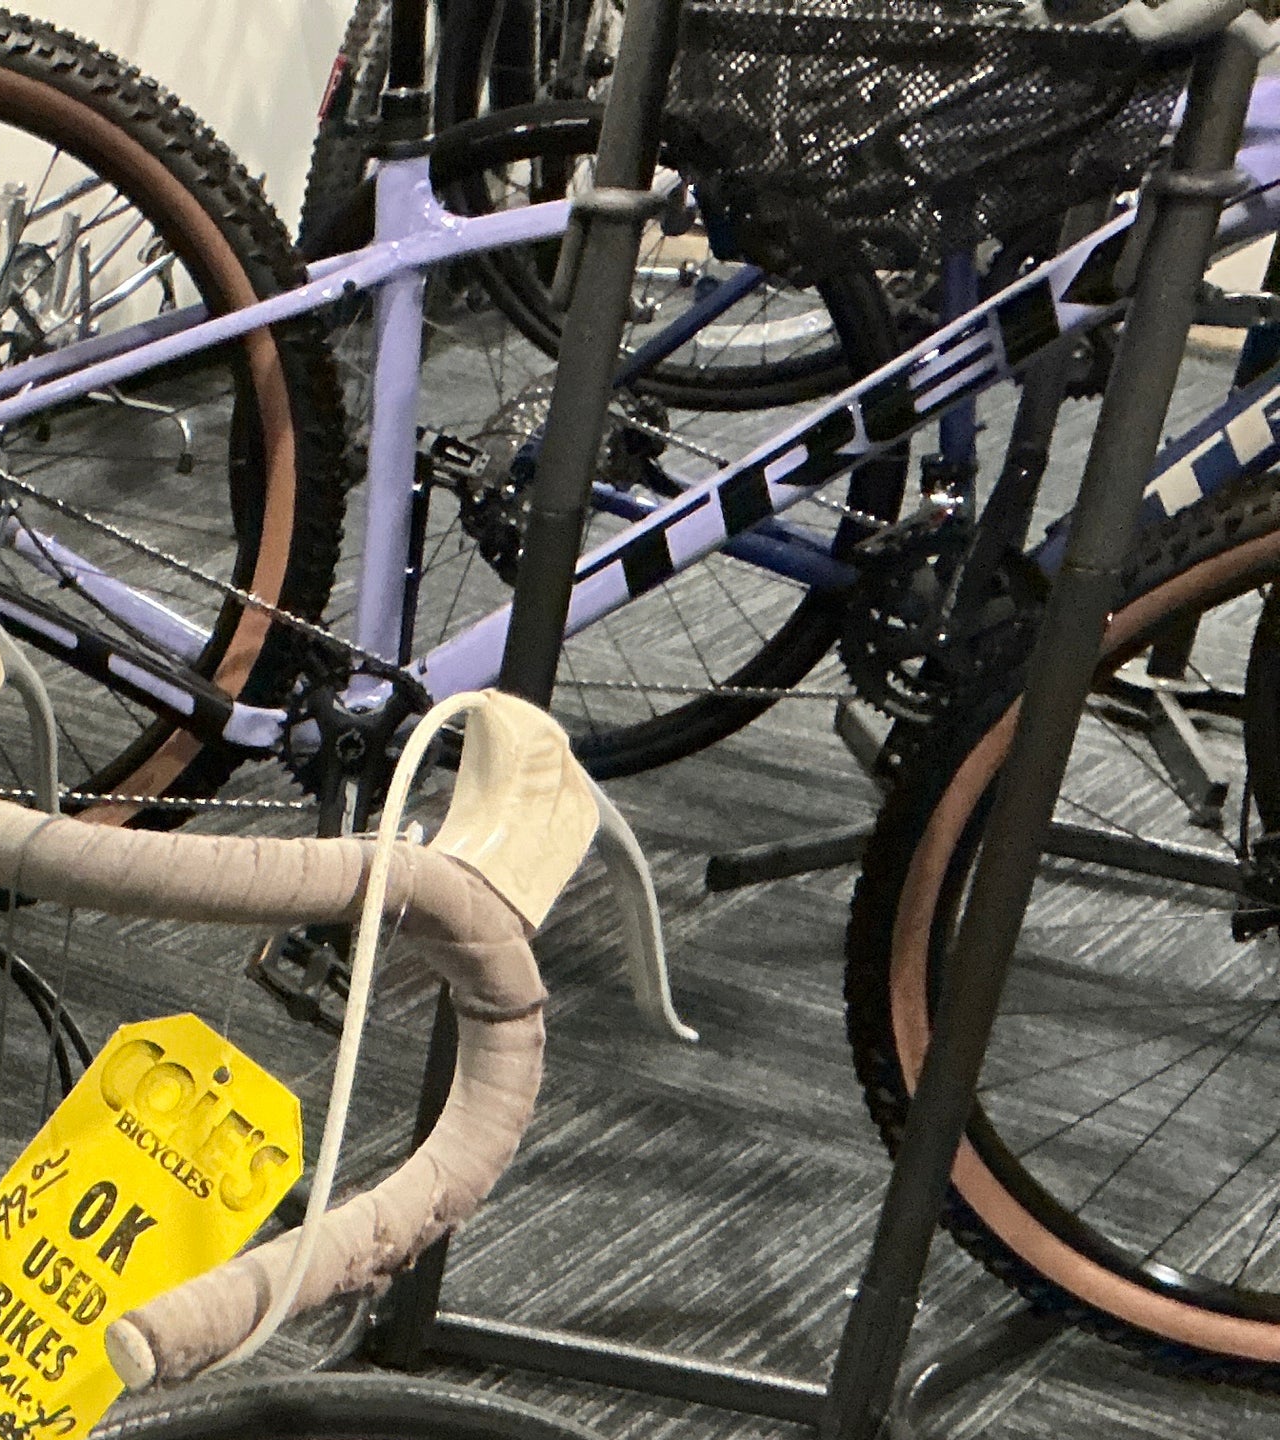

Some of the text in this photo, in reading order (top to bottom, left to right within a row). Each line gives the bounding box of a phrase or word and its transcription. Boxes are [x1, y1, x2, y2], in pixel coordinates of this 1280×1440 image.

[575, 226, 1130, 598] TREK
[114, 1108, 216, 1200] BICYCLES
[68, 1180, 159, 1277] OK
[22, 1237, 107, 1326] USED
